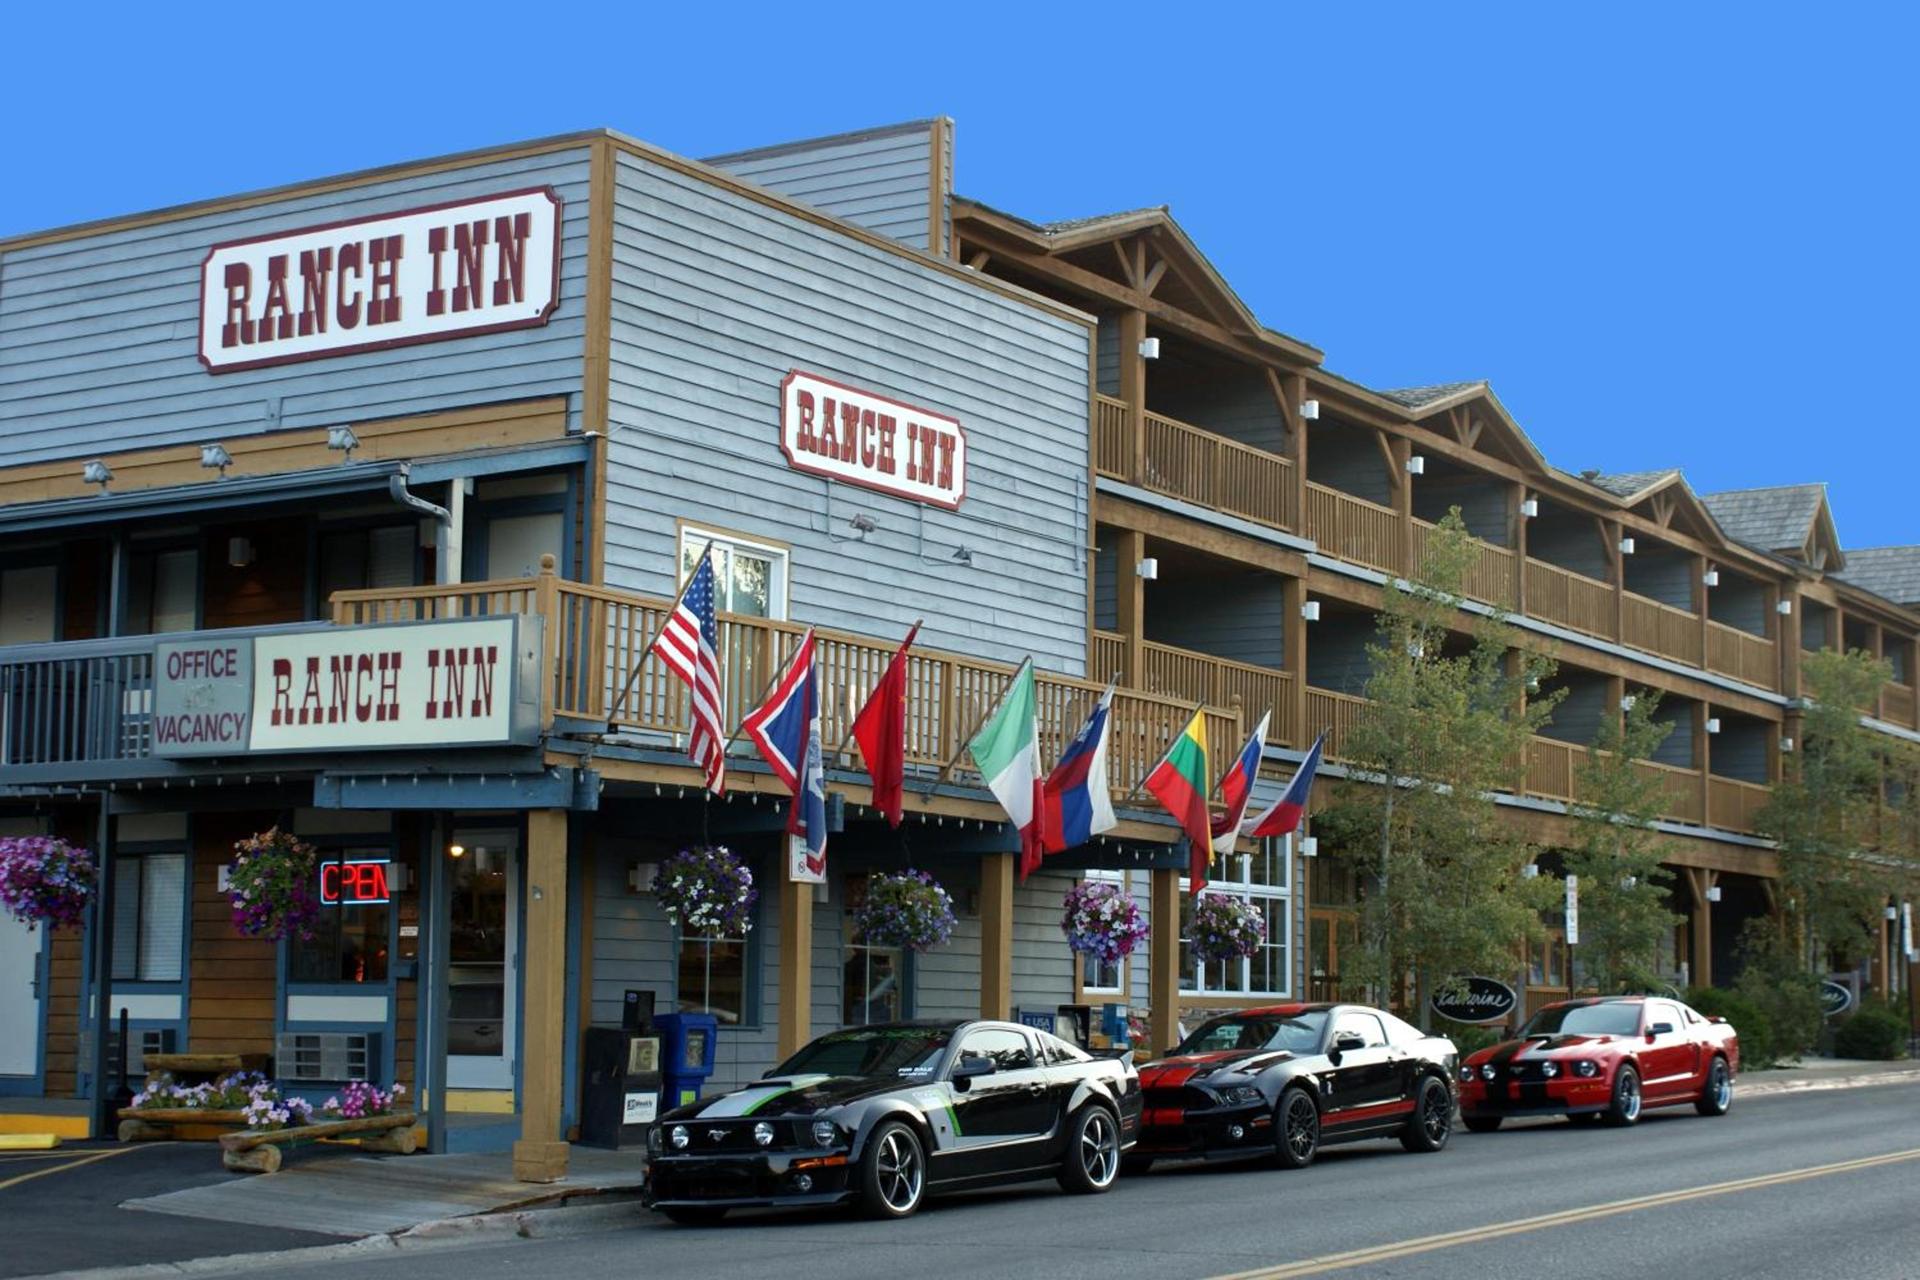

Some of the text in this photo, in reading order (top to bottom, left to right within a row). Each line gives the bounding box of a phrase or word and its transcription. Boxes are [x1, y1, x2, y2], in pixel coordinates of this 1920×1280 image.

[222, 211, 532, 349] RANCH INN
[797, 389, 956, 491] RANCH INN
[167, 648, 238, 681] OFFICE
[271, 645, 498, 727] RANCH INN
[155, 712, 246, 744] VACANCY
[322, 864, 390, 900] OPEN
[1032, 1017, 1050, 1027] USA
